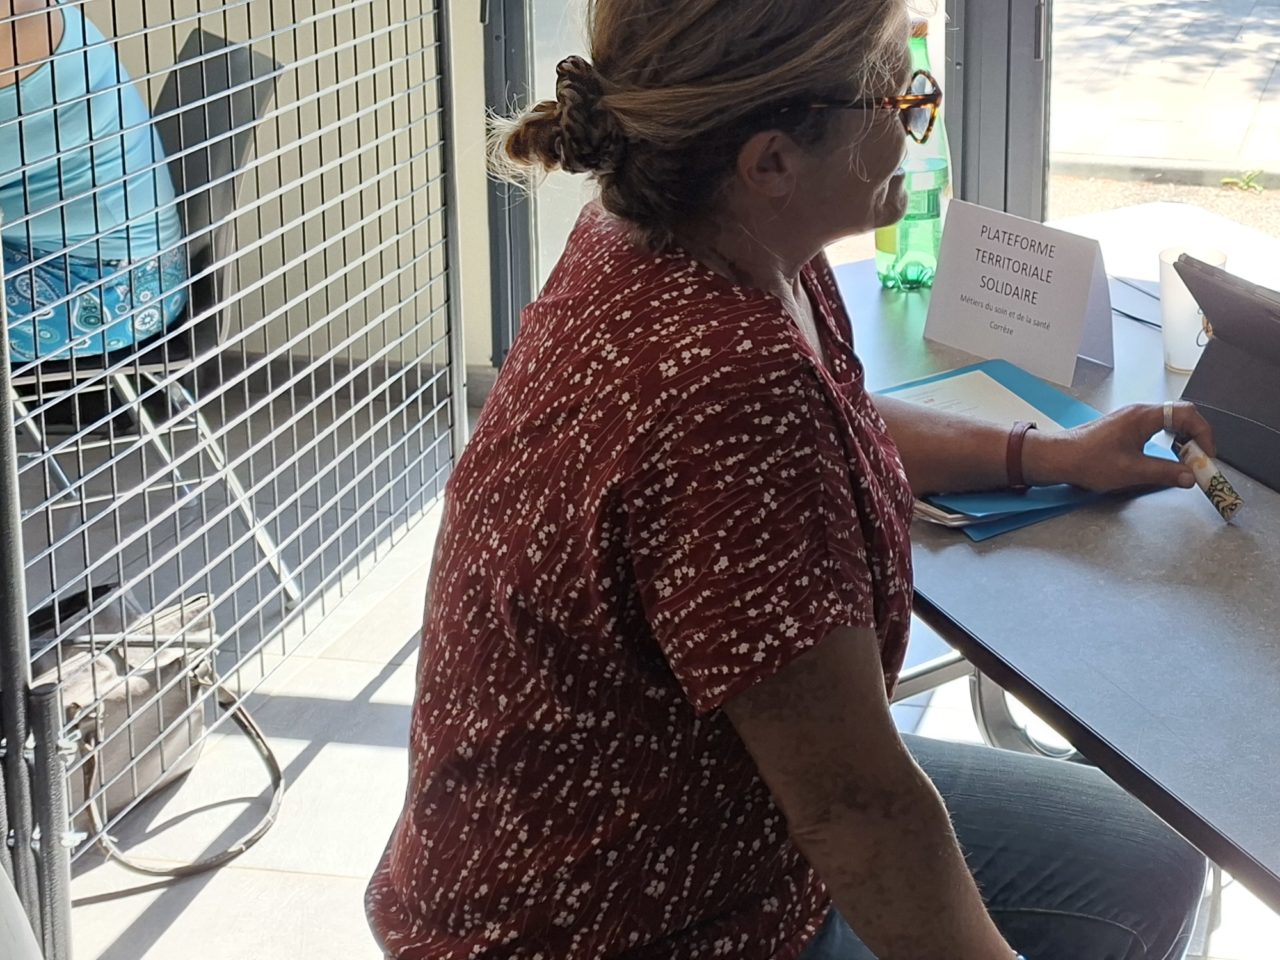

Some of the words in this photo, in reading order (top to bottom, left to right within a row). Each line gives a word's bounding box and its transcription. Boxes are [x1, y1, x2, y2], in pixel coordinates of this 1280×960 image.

[980, 225, 1056, 258] PLATEFORME
[976, 248, 1053, 284] TERRITORIALE
[980, 276, 1038, 306] SOLIDAIRE
[960, 294, 984, 309] Métiers
[985, 302, 994, 312] du
[994, 305, 1008, 316] soin
[1008, 310, 1016, 318] et
[1017, 312, 1025, 322] de
[1026, 315, 1032, 324] la
[1033, 318, 1050, 330] santé
[990, 321, 1014, 336] Corrèze
